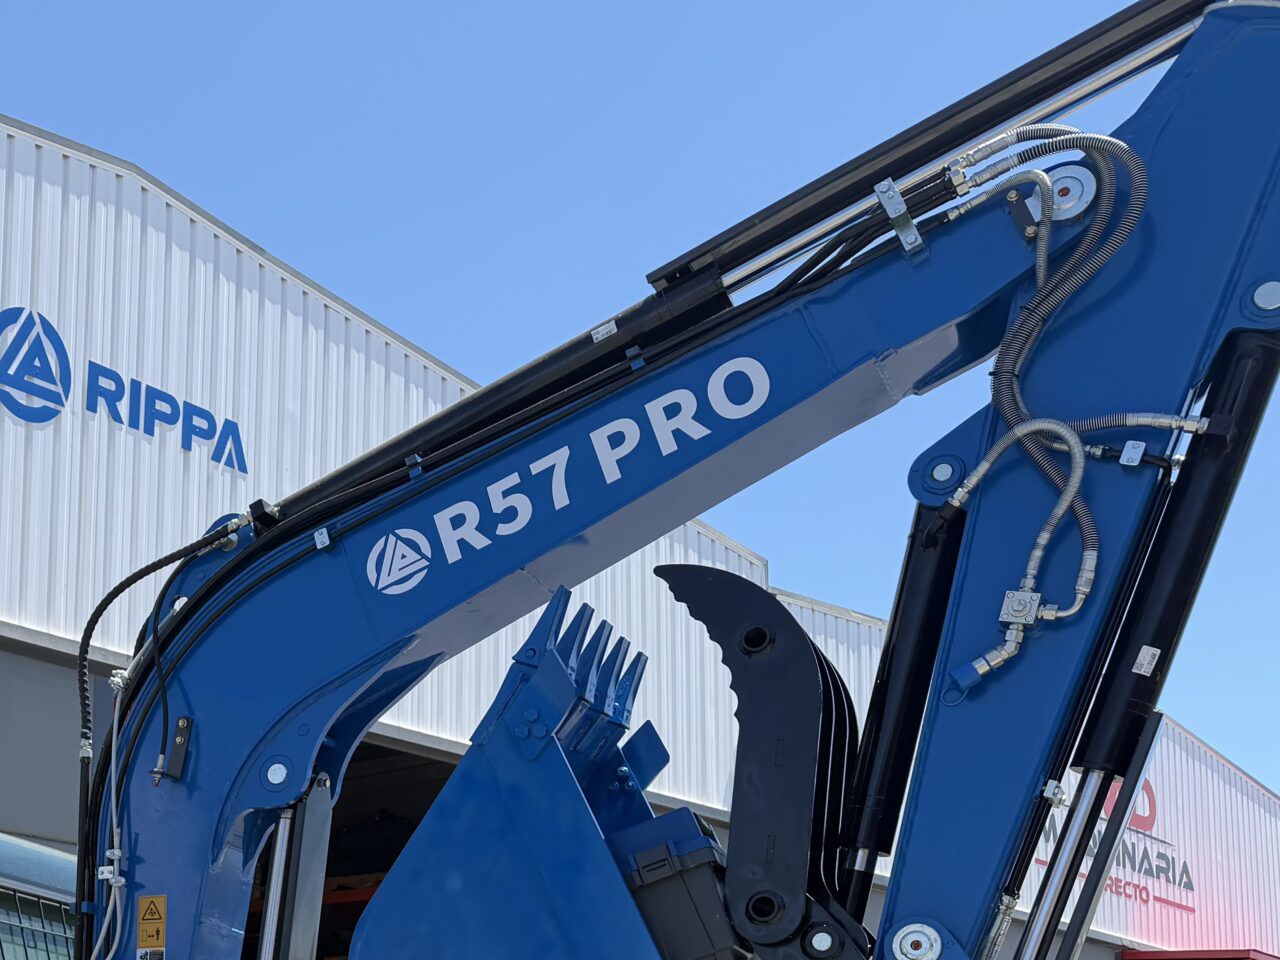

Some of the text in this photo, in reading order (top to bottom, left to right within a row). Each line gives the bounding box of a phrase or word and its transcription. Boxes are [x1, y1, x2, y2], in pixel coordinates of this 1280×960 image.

[86, 359, 249, 475] RIPPA
[433, 356, 771, 565] R57 PRO
